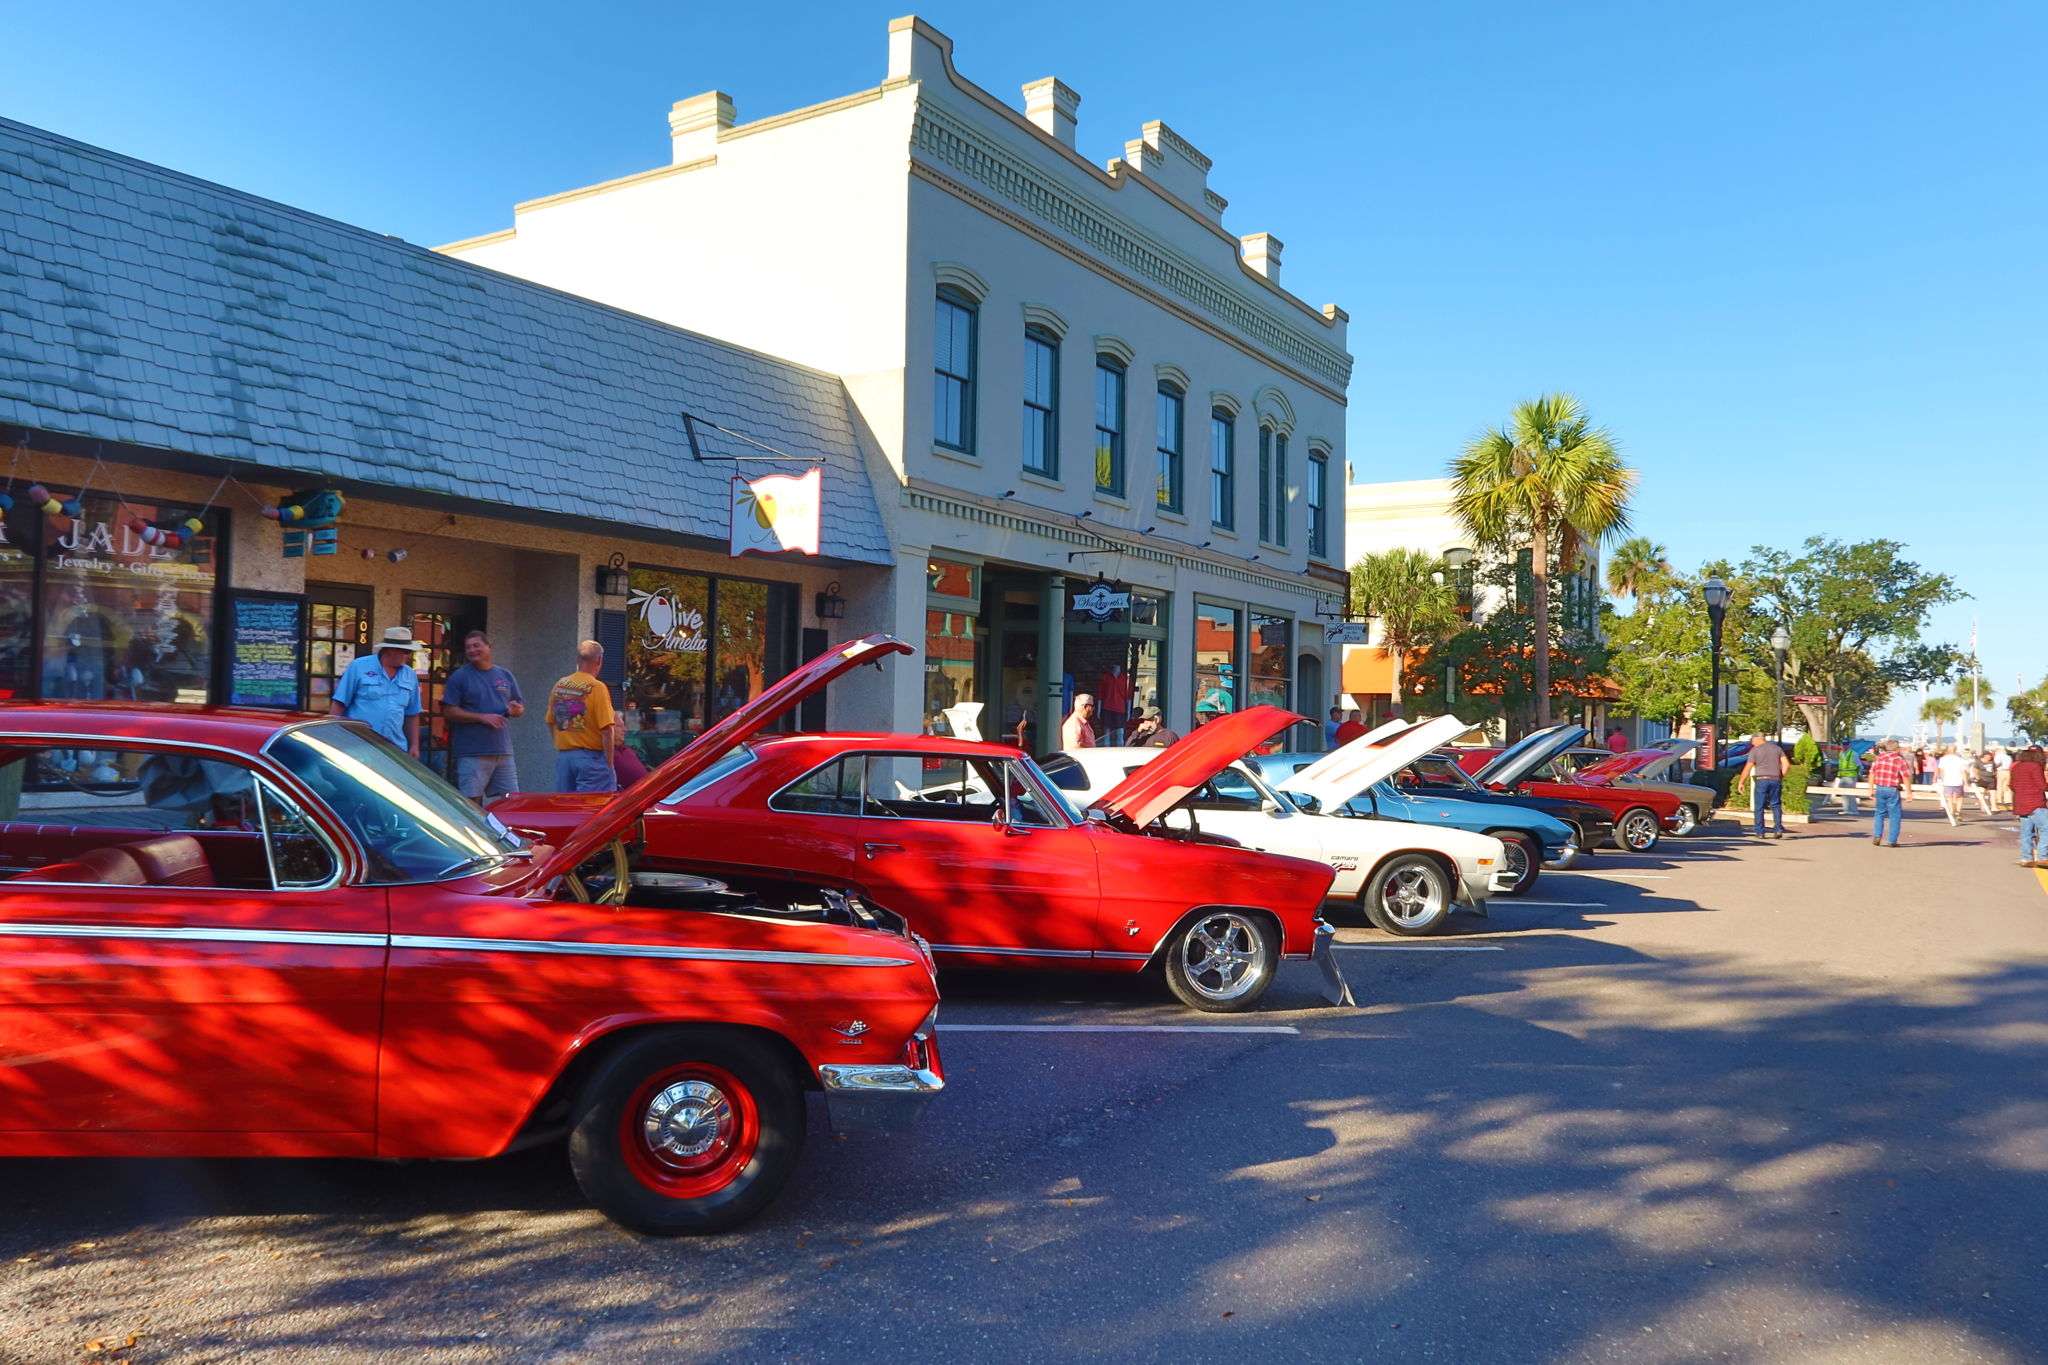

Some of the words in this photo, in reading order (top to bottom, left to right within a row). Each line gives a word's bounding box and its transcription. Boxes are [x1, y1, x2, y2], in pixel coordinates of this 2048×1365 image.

[56, 554, 113, 575] Jewelry
[360, 608, 368, 644] 208
[648, 594, 704, 636] Olive
[642, 627, 708, 651] Amelia
